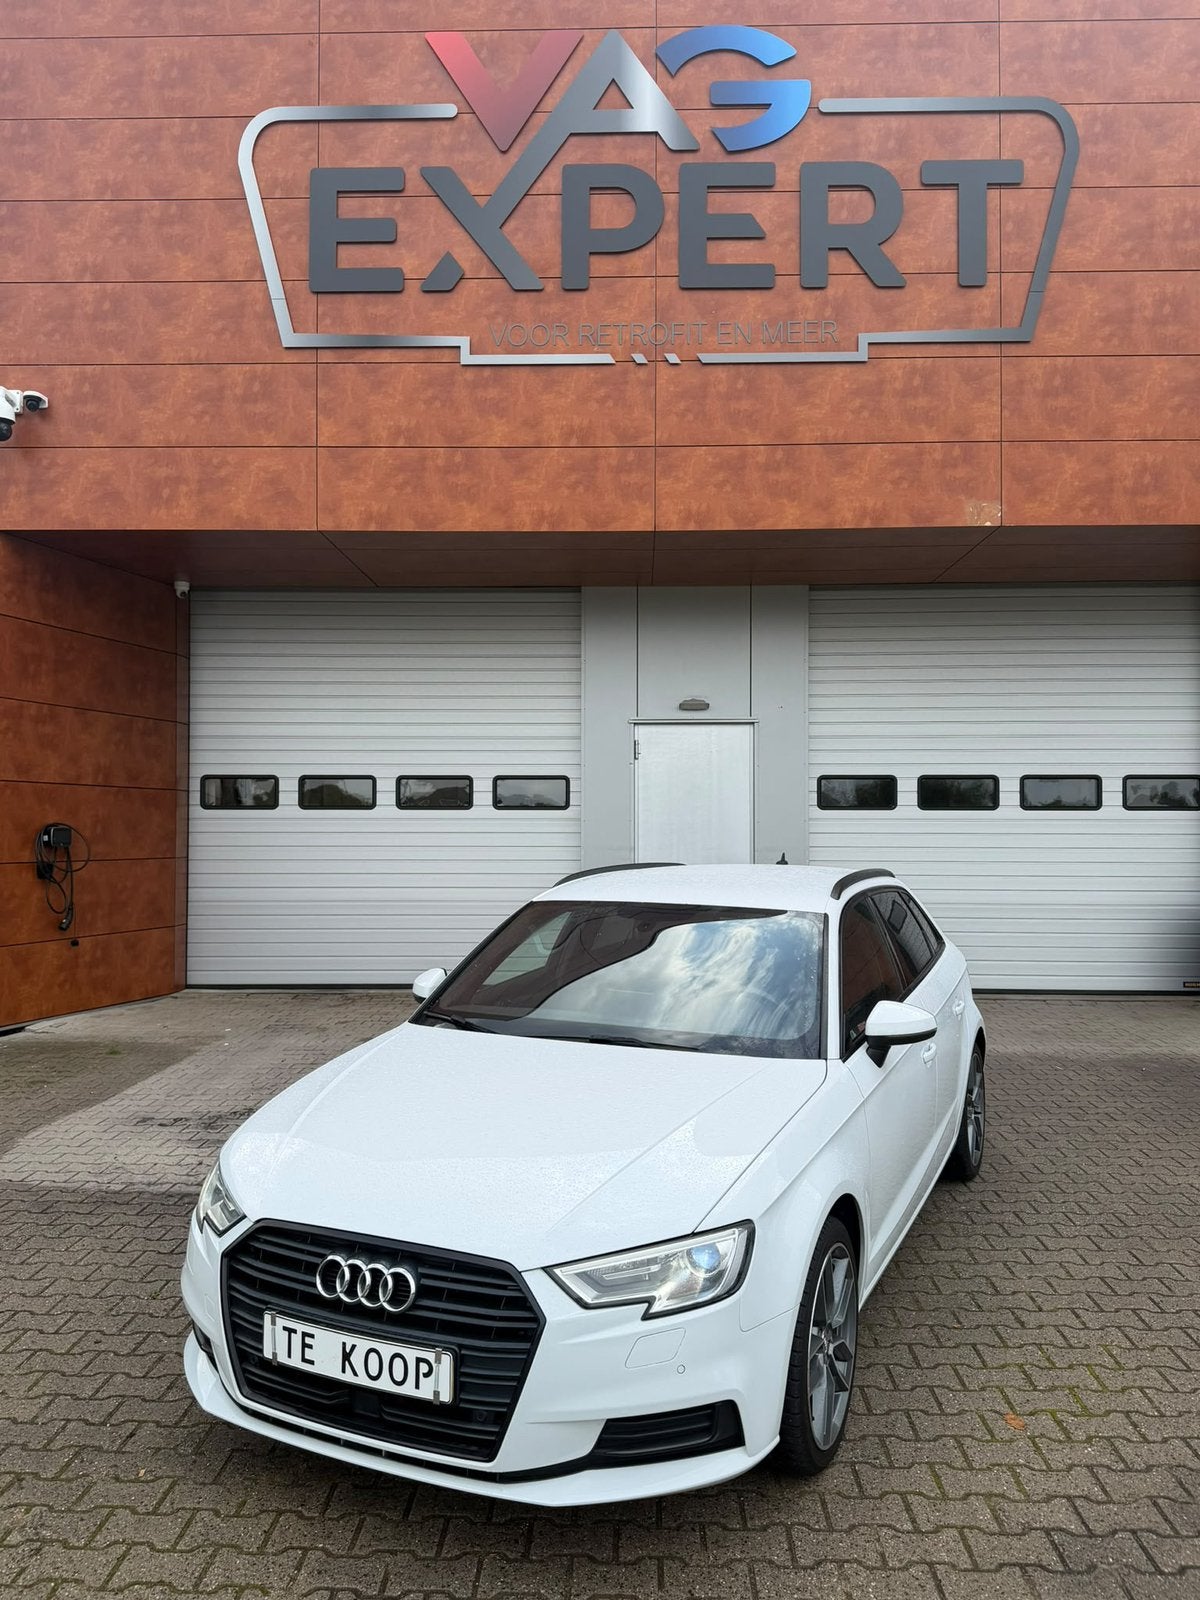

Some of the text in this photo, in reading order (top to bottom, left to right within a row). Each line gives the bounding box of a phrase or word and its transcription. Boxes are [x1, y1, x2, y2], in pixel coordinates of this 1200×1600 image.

[424, 24, 812, 152] VAG
[308, 159, 1024, 293] EXPERT
[489, 319, 839, 348] VOOR RETROFIT EN MEER
[282, 1325, 434, 1390] TE KOOP
